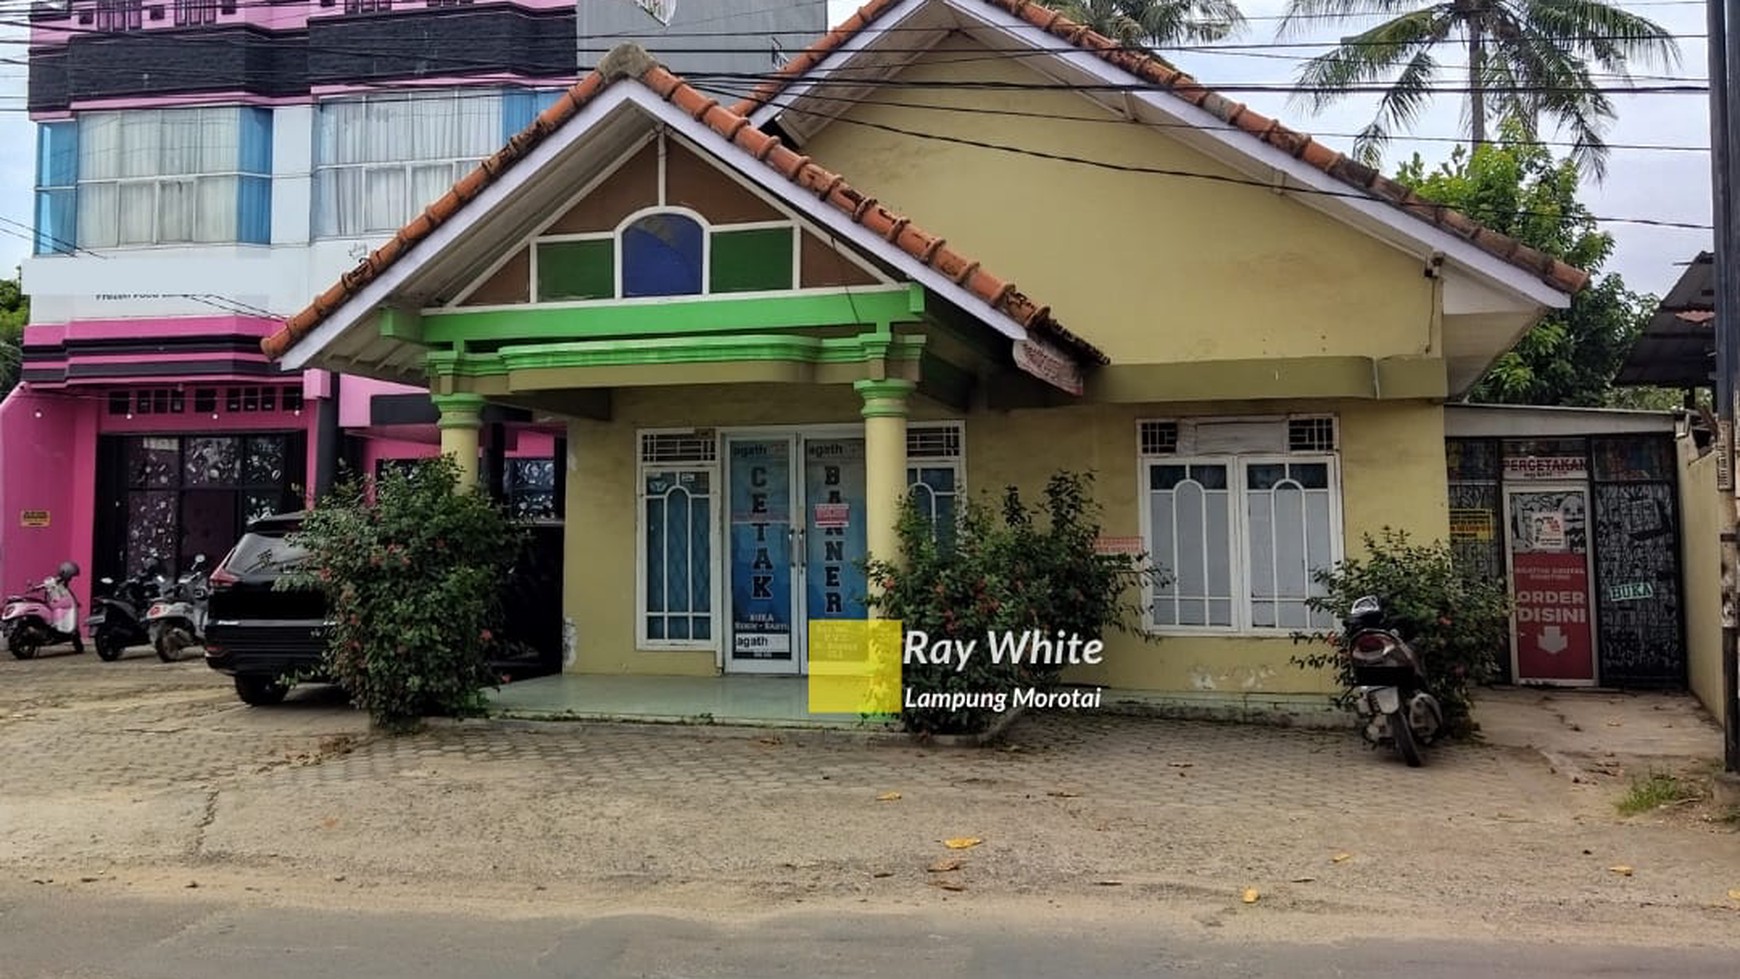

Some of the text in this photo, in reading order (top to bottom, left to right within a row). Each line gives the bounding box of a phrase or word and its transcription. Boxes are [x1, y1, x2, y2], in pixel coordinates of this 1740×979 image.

[809, 444, 844, 457] agath
[751, 466, 773, 599] CETAK
[1517, 591, 1585, 604] ORDER
[1612, 584, 1652, 600] BUKA
[1517, 607, 1586, 623] DISINI
[736, 635, 769, 648] agath
